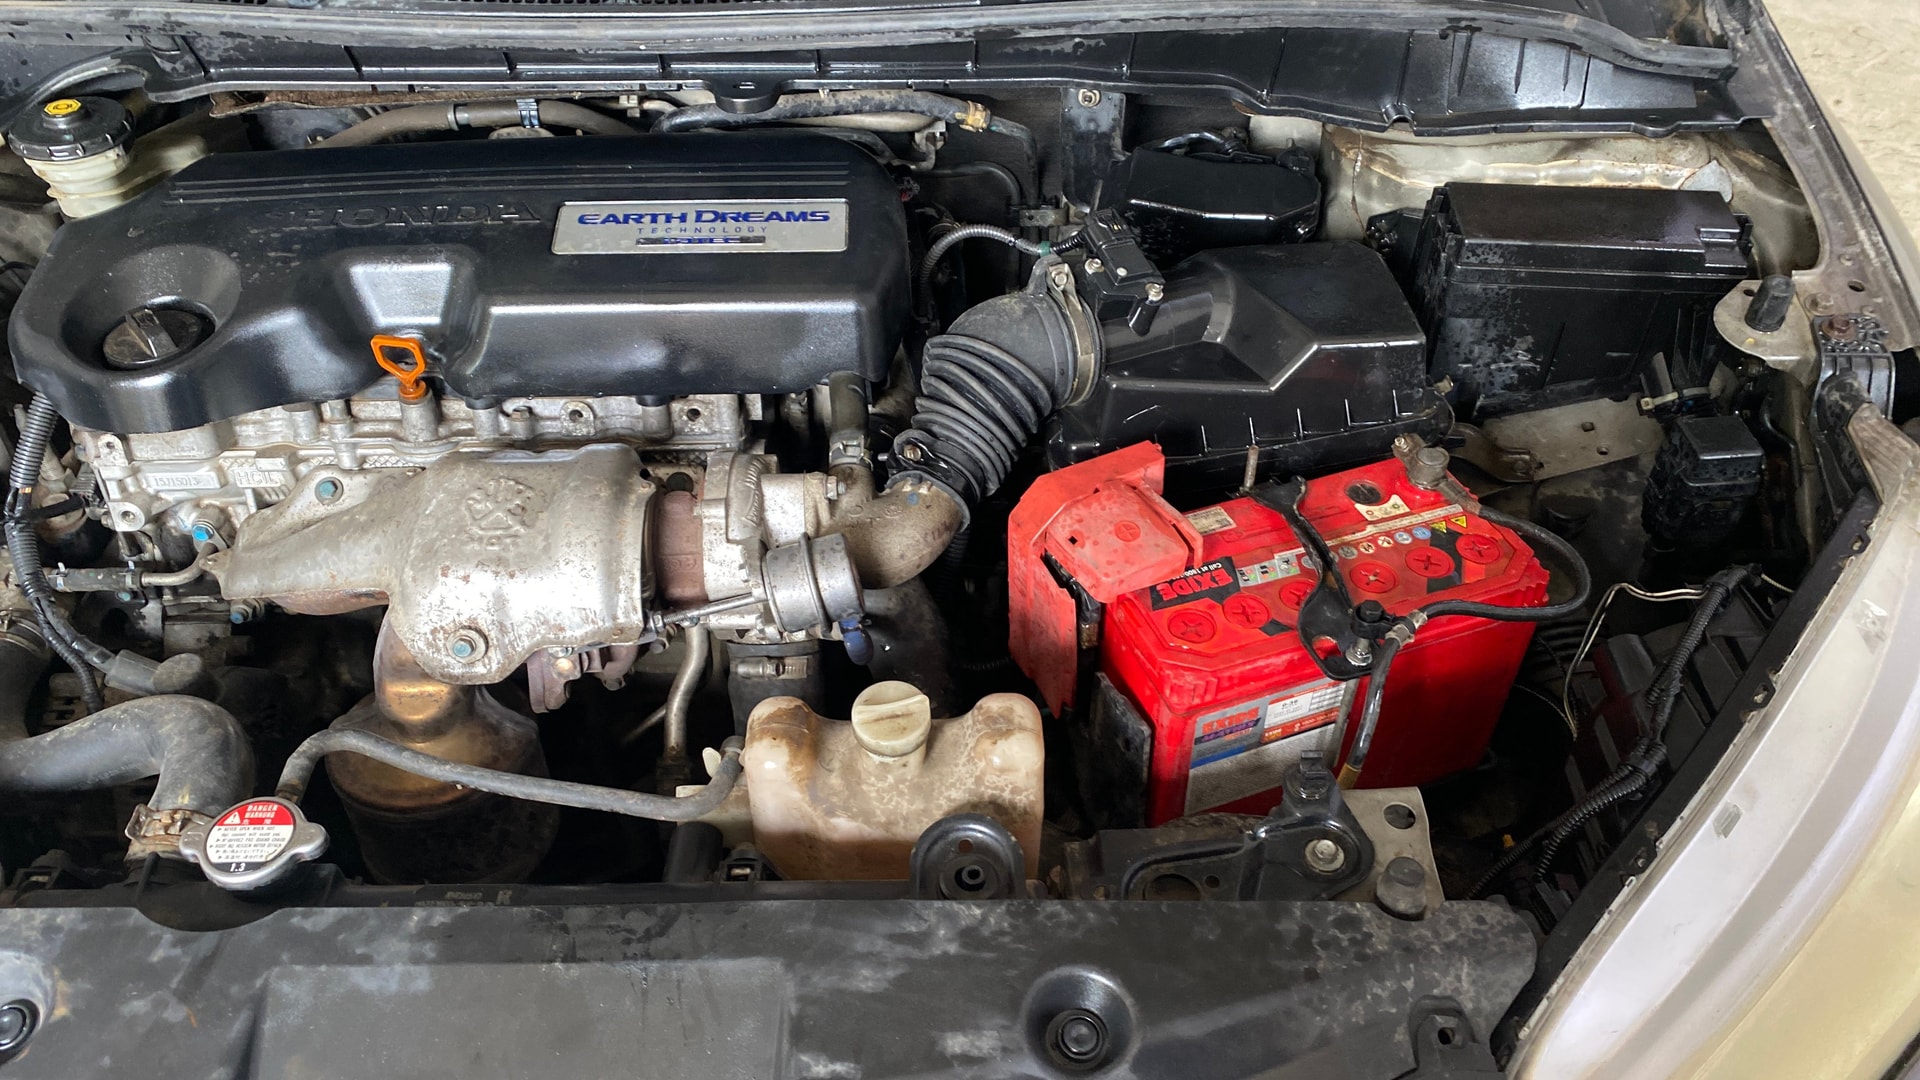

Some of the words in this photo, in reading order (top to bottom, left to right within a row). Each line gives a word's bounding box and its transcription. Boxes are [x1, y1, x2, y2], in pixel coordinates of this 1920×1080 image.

[283, 203, 541, 229] HONDA
[577, 211, 687, 225] EARTH
[637, 226, 768, 234] TECHNOLOGY
[1156, 568, 1233, 601] EXIDE
[247, 804, 279, 812] DANGER
[230, 862, 246, 872] 1.3
